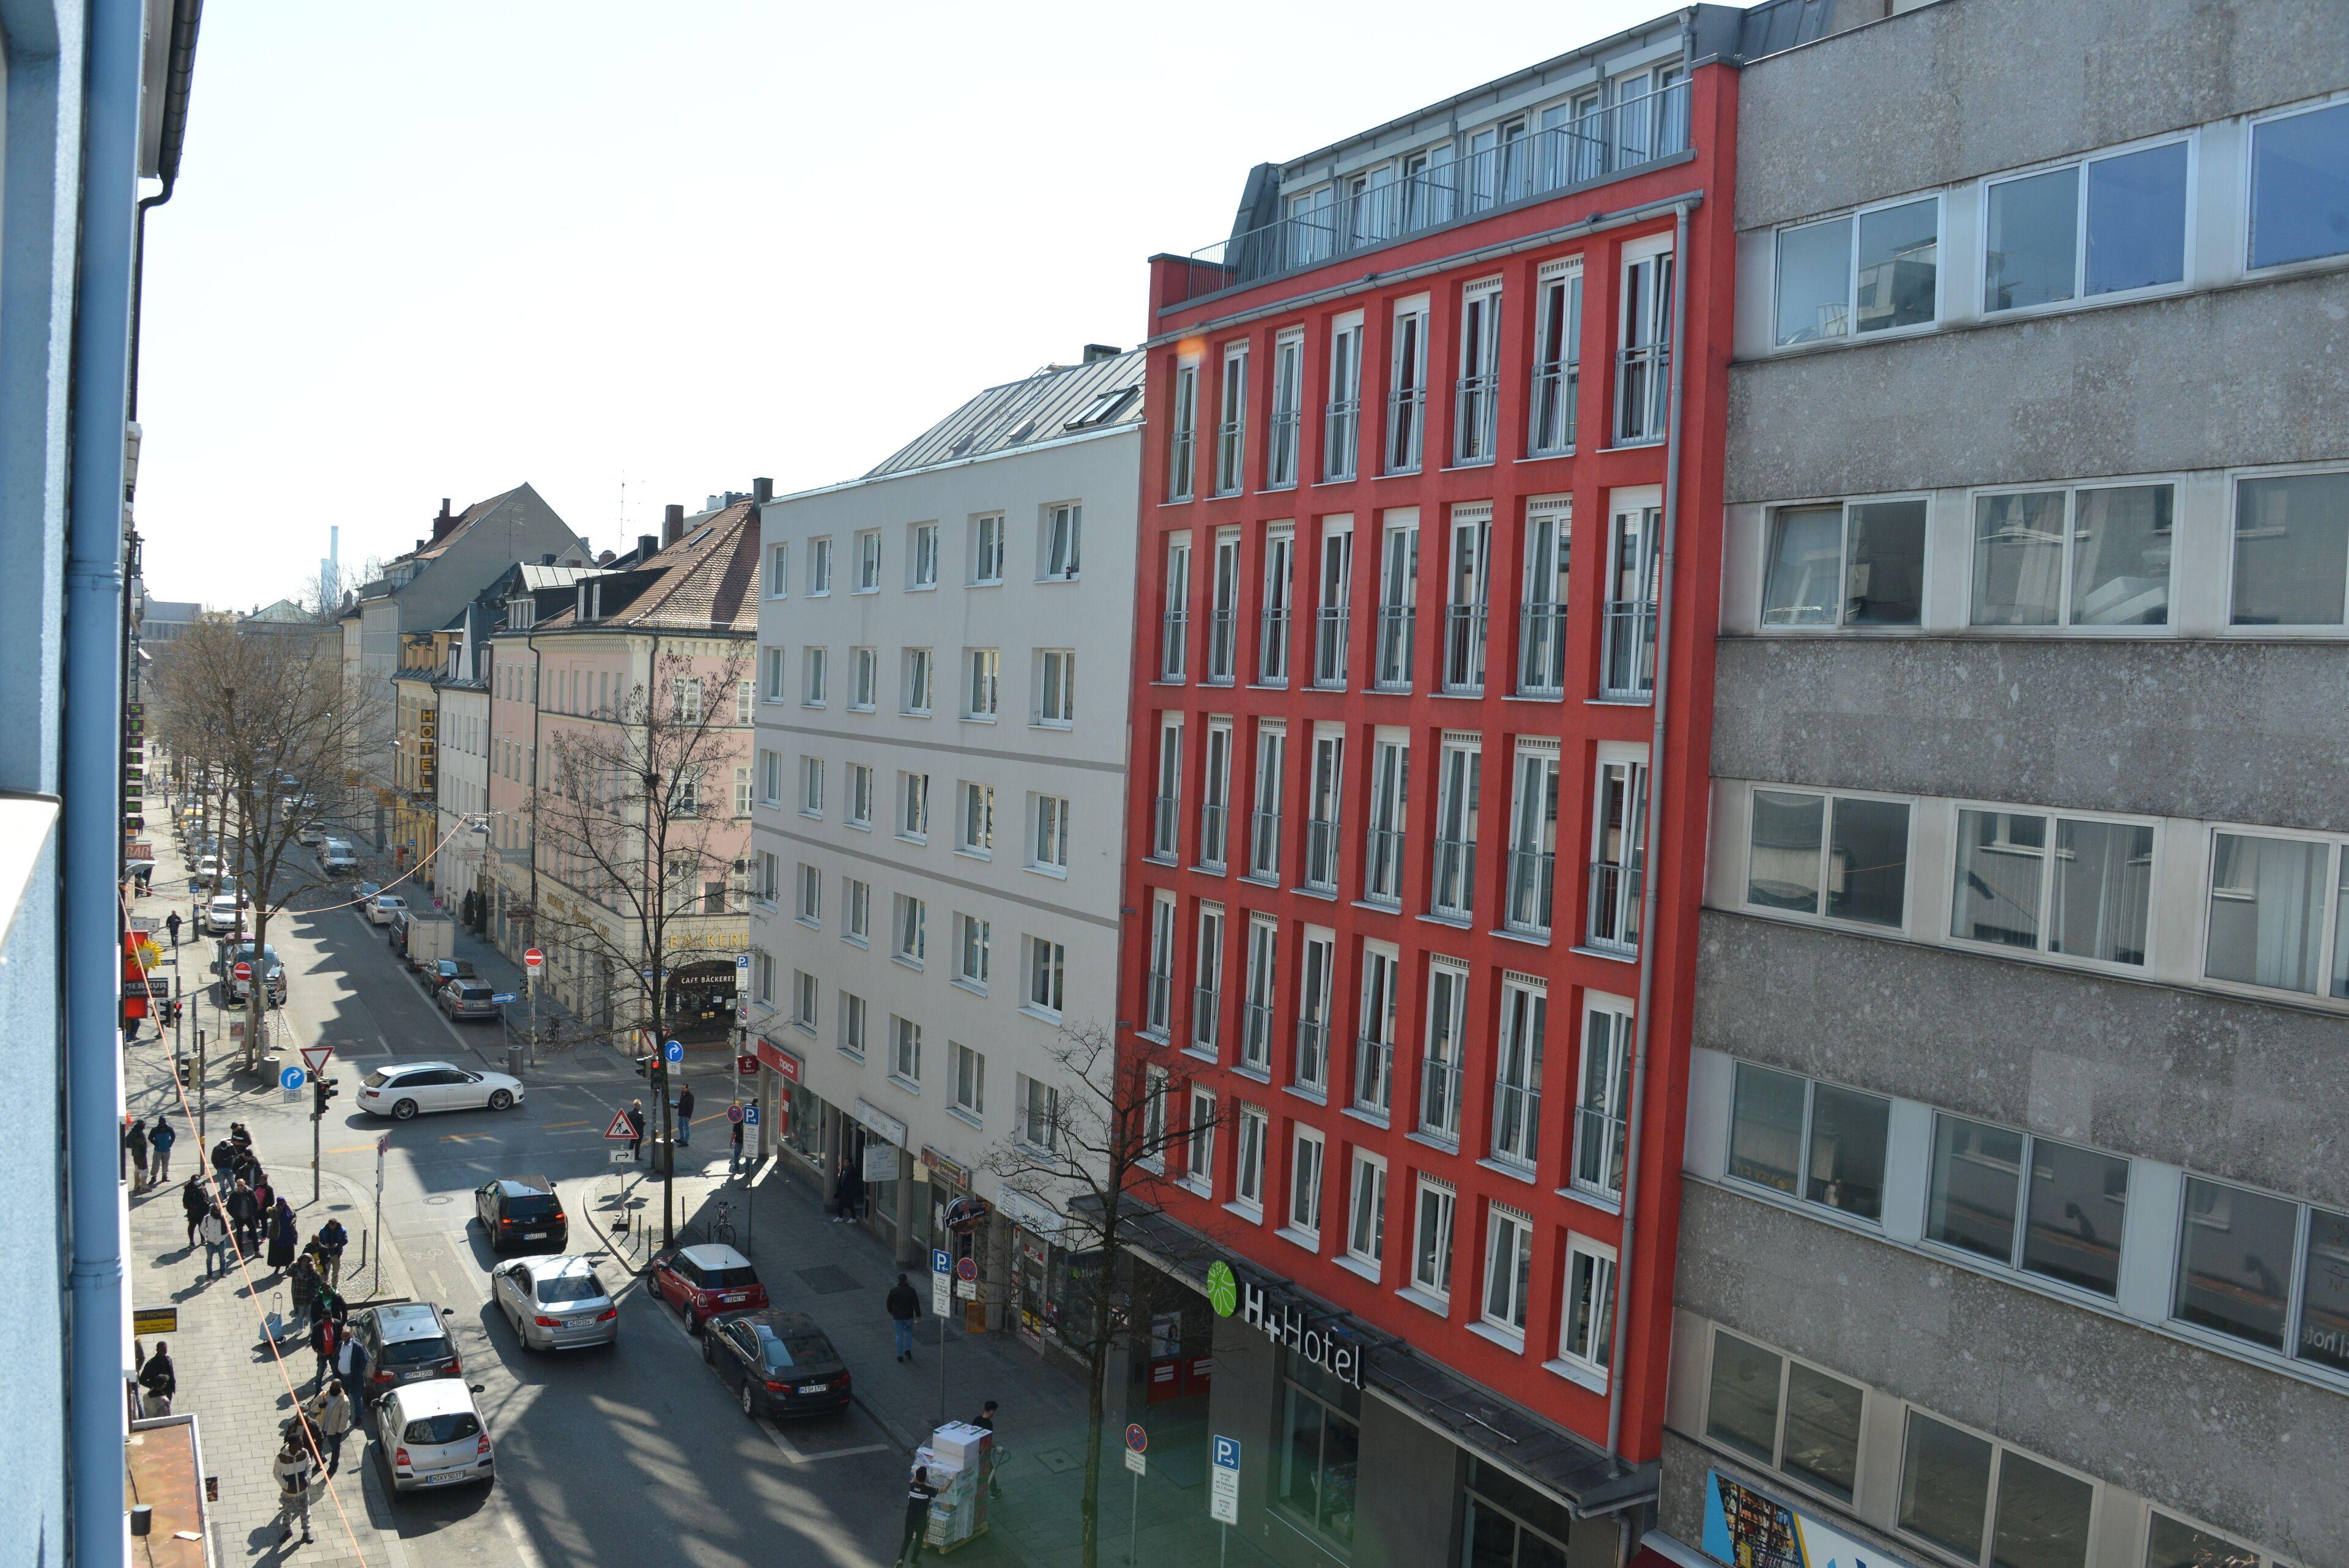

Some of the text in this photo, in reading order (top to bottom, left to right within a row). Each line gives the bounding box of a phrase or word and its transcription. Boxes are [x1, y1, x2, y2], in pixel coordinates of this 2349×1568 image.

[421, 710, 434, 787] HOTEL
[126, 846, 150, 857] BAR
[670, 933, 749, 949] BÄCKERE
